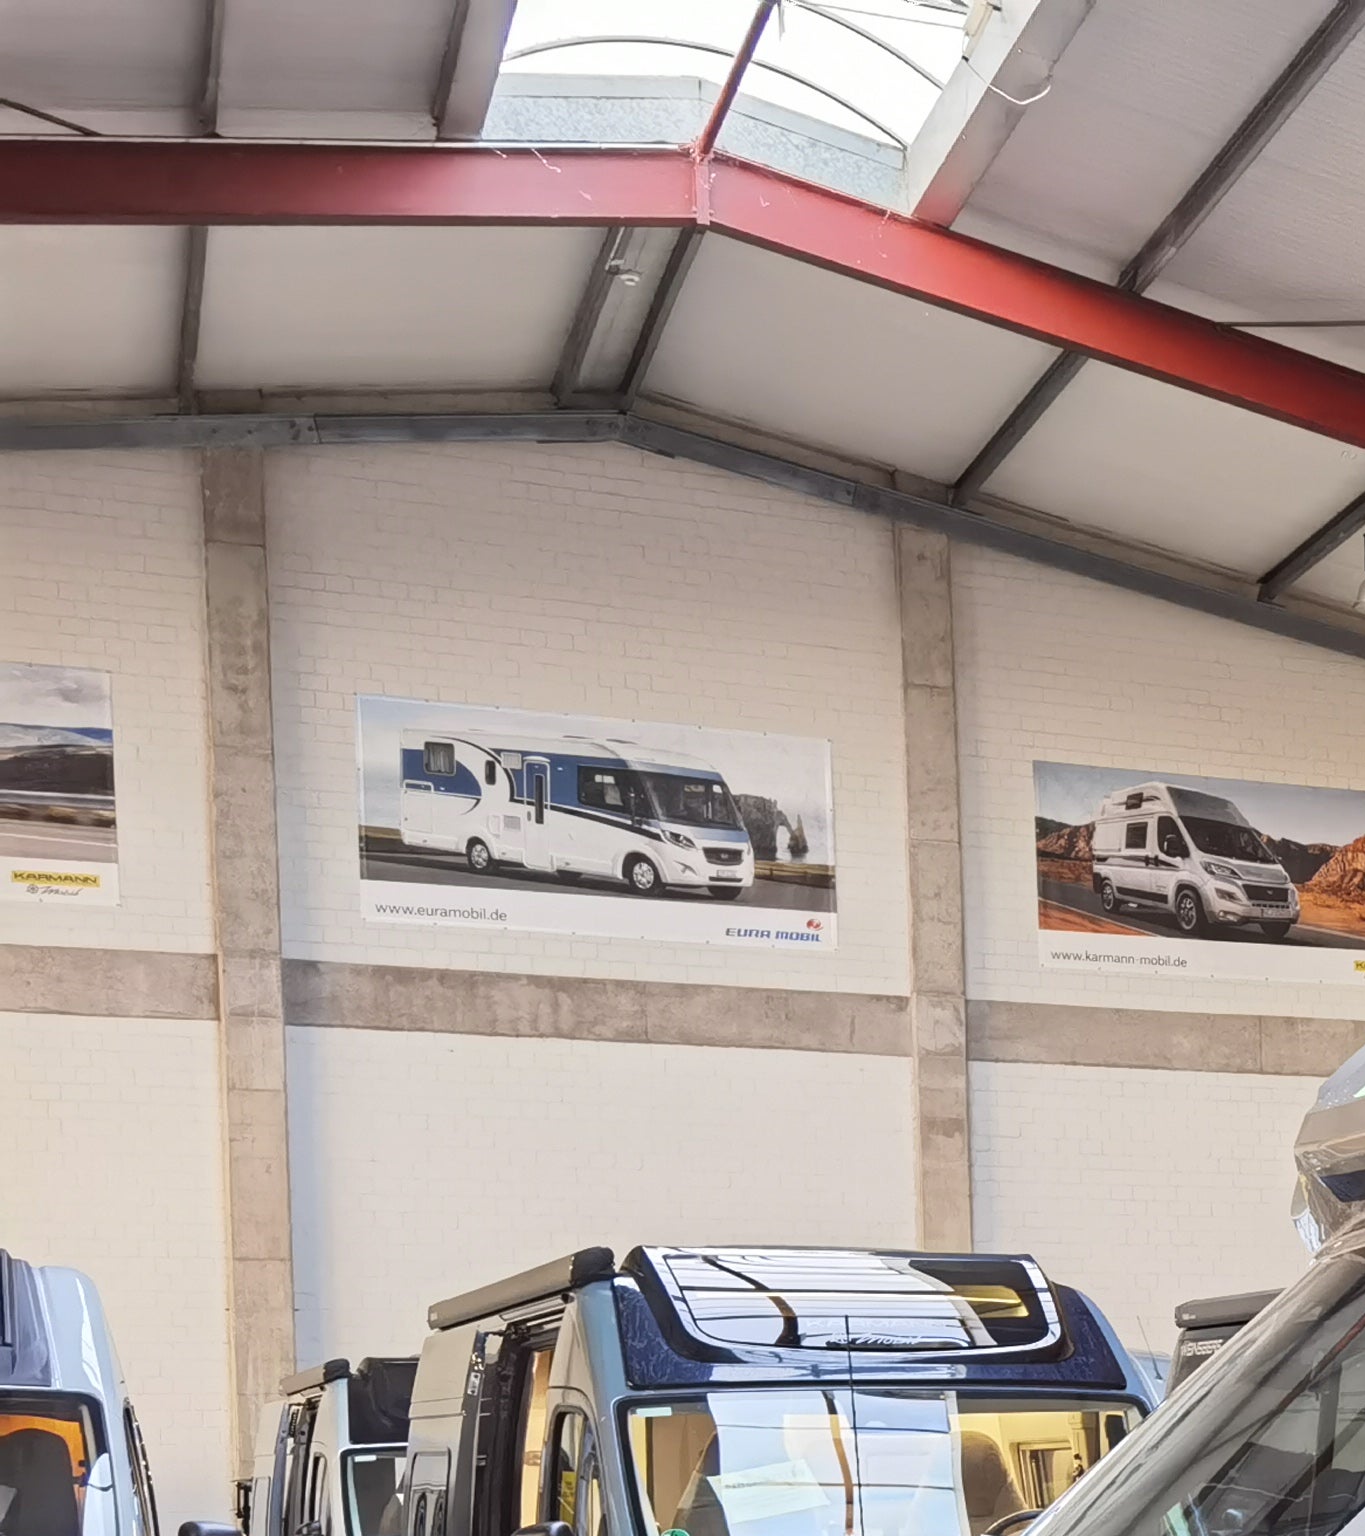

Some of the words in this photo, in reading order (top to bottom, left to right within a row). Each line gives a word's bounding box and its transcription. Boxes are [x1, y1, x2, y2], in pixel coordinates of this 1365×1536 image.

[13, 872, 97, 884] KARMANN
[375, 903, 507, 921] www.euramobil.de
[725, 927, 771, 939] EURA
[775, 931, 821, 943] MOBIL
[1051, 950, 1187, 967] www.karmann-mobil.de
